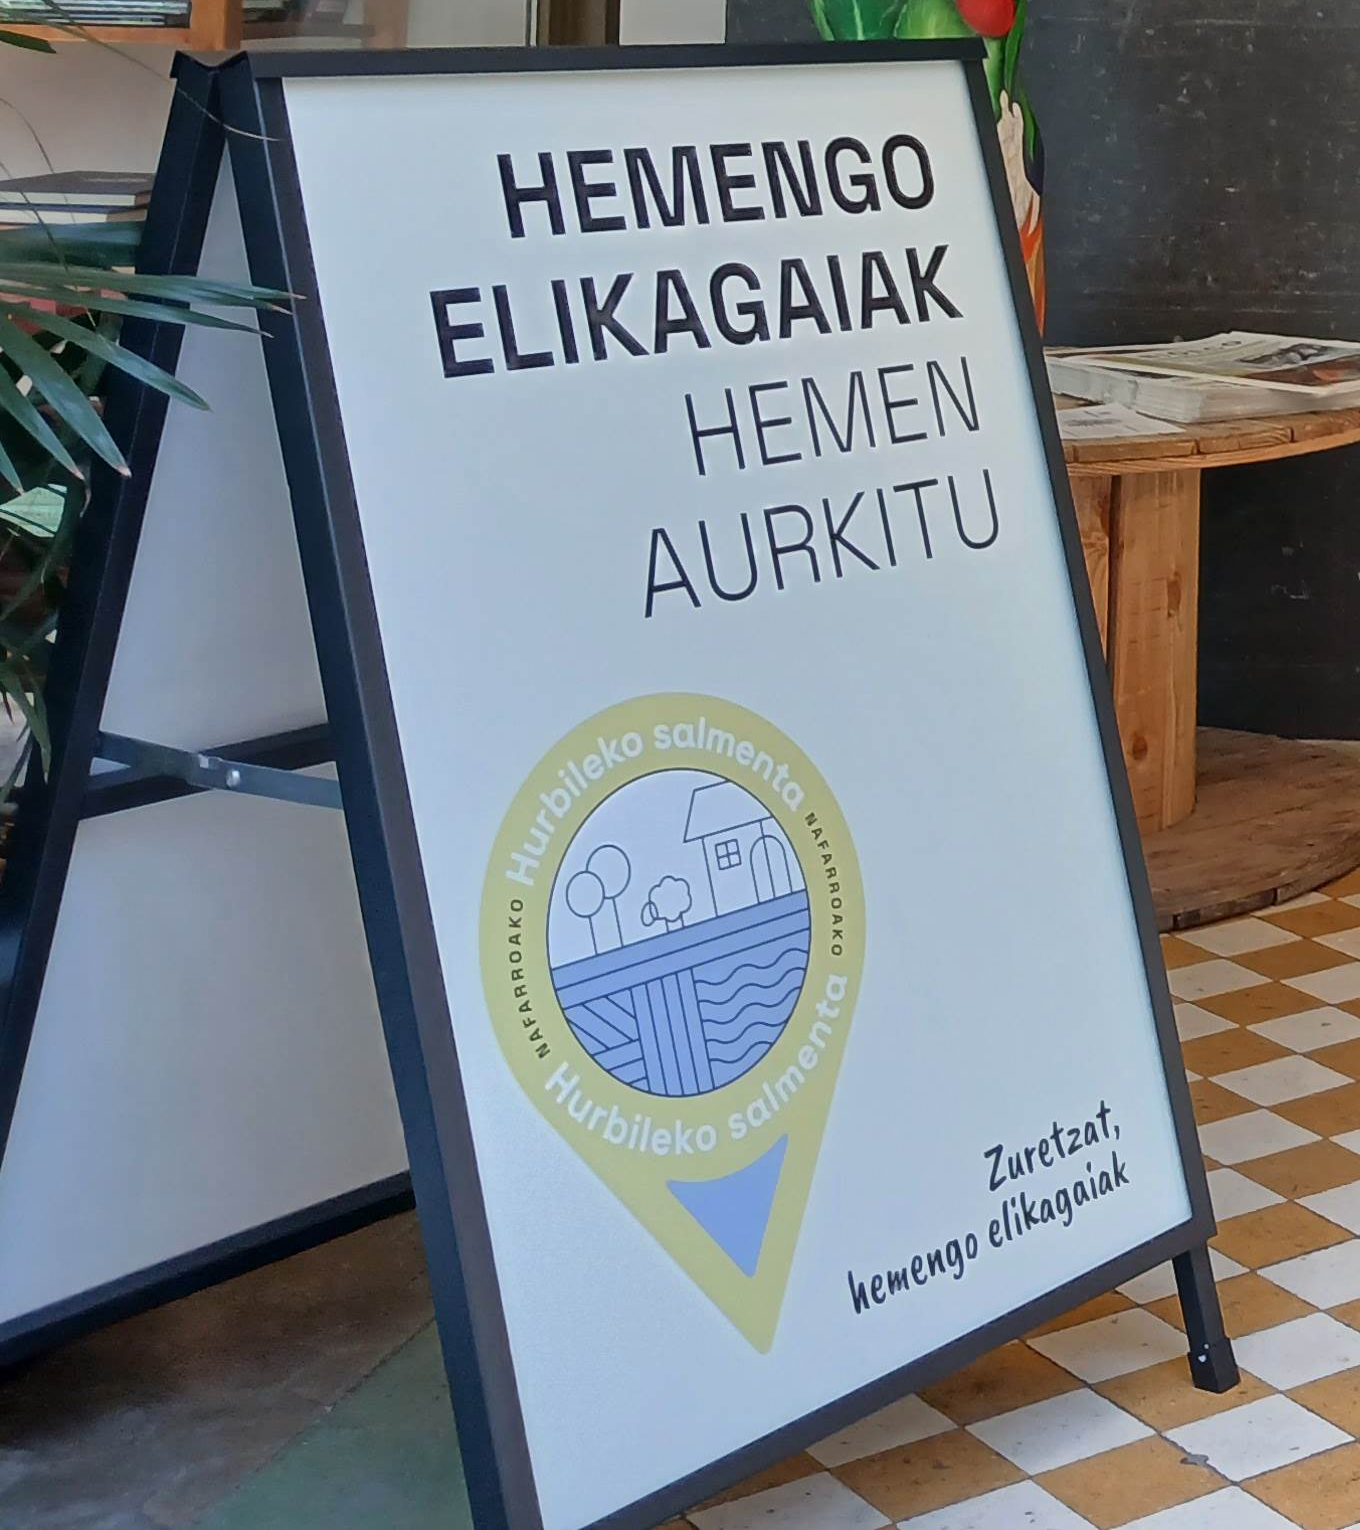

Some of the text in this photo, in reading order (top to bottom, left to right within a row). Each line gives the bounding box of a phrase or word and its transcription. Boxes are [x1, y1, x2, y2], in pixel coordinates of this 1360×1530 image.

[496, 134, 935, 239] HEMENGO
[429, 244, 964, 379] ELIKAGAIAK
[683, 356, 981, 476] HEMEN
[643, 469, 1001, 619] AURKITU
[505, 716, 806, 886] Hurbileko salmenta
[803, 812, 844, 957] NAFARROAKO
[507, 898, 551, 1059] NAFARROAKO
[544, 974, 848, 1155] Hurbileko salmenta
[983, 1100, 1121, 1192] Zuretzat,
[847, 1151, 1130, 1315] hemengo elikagaiak
